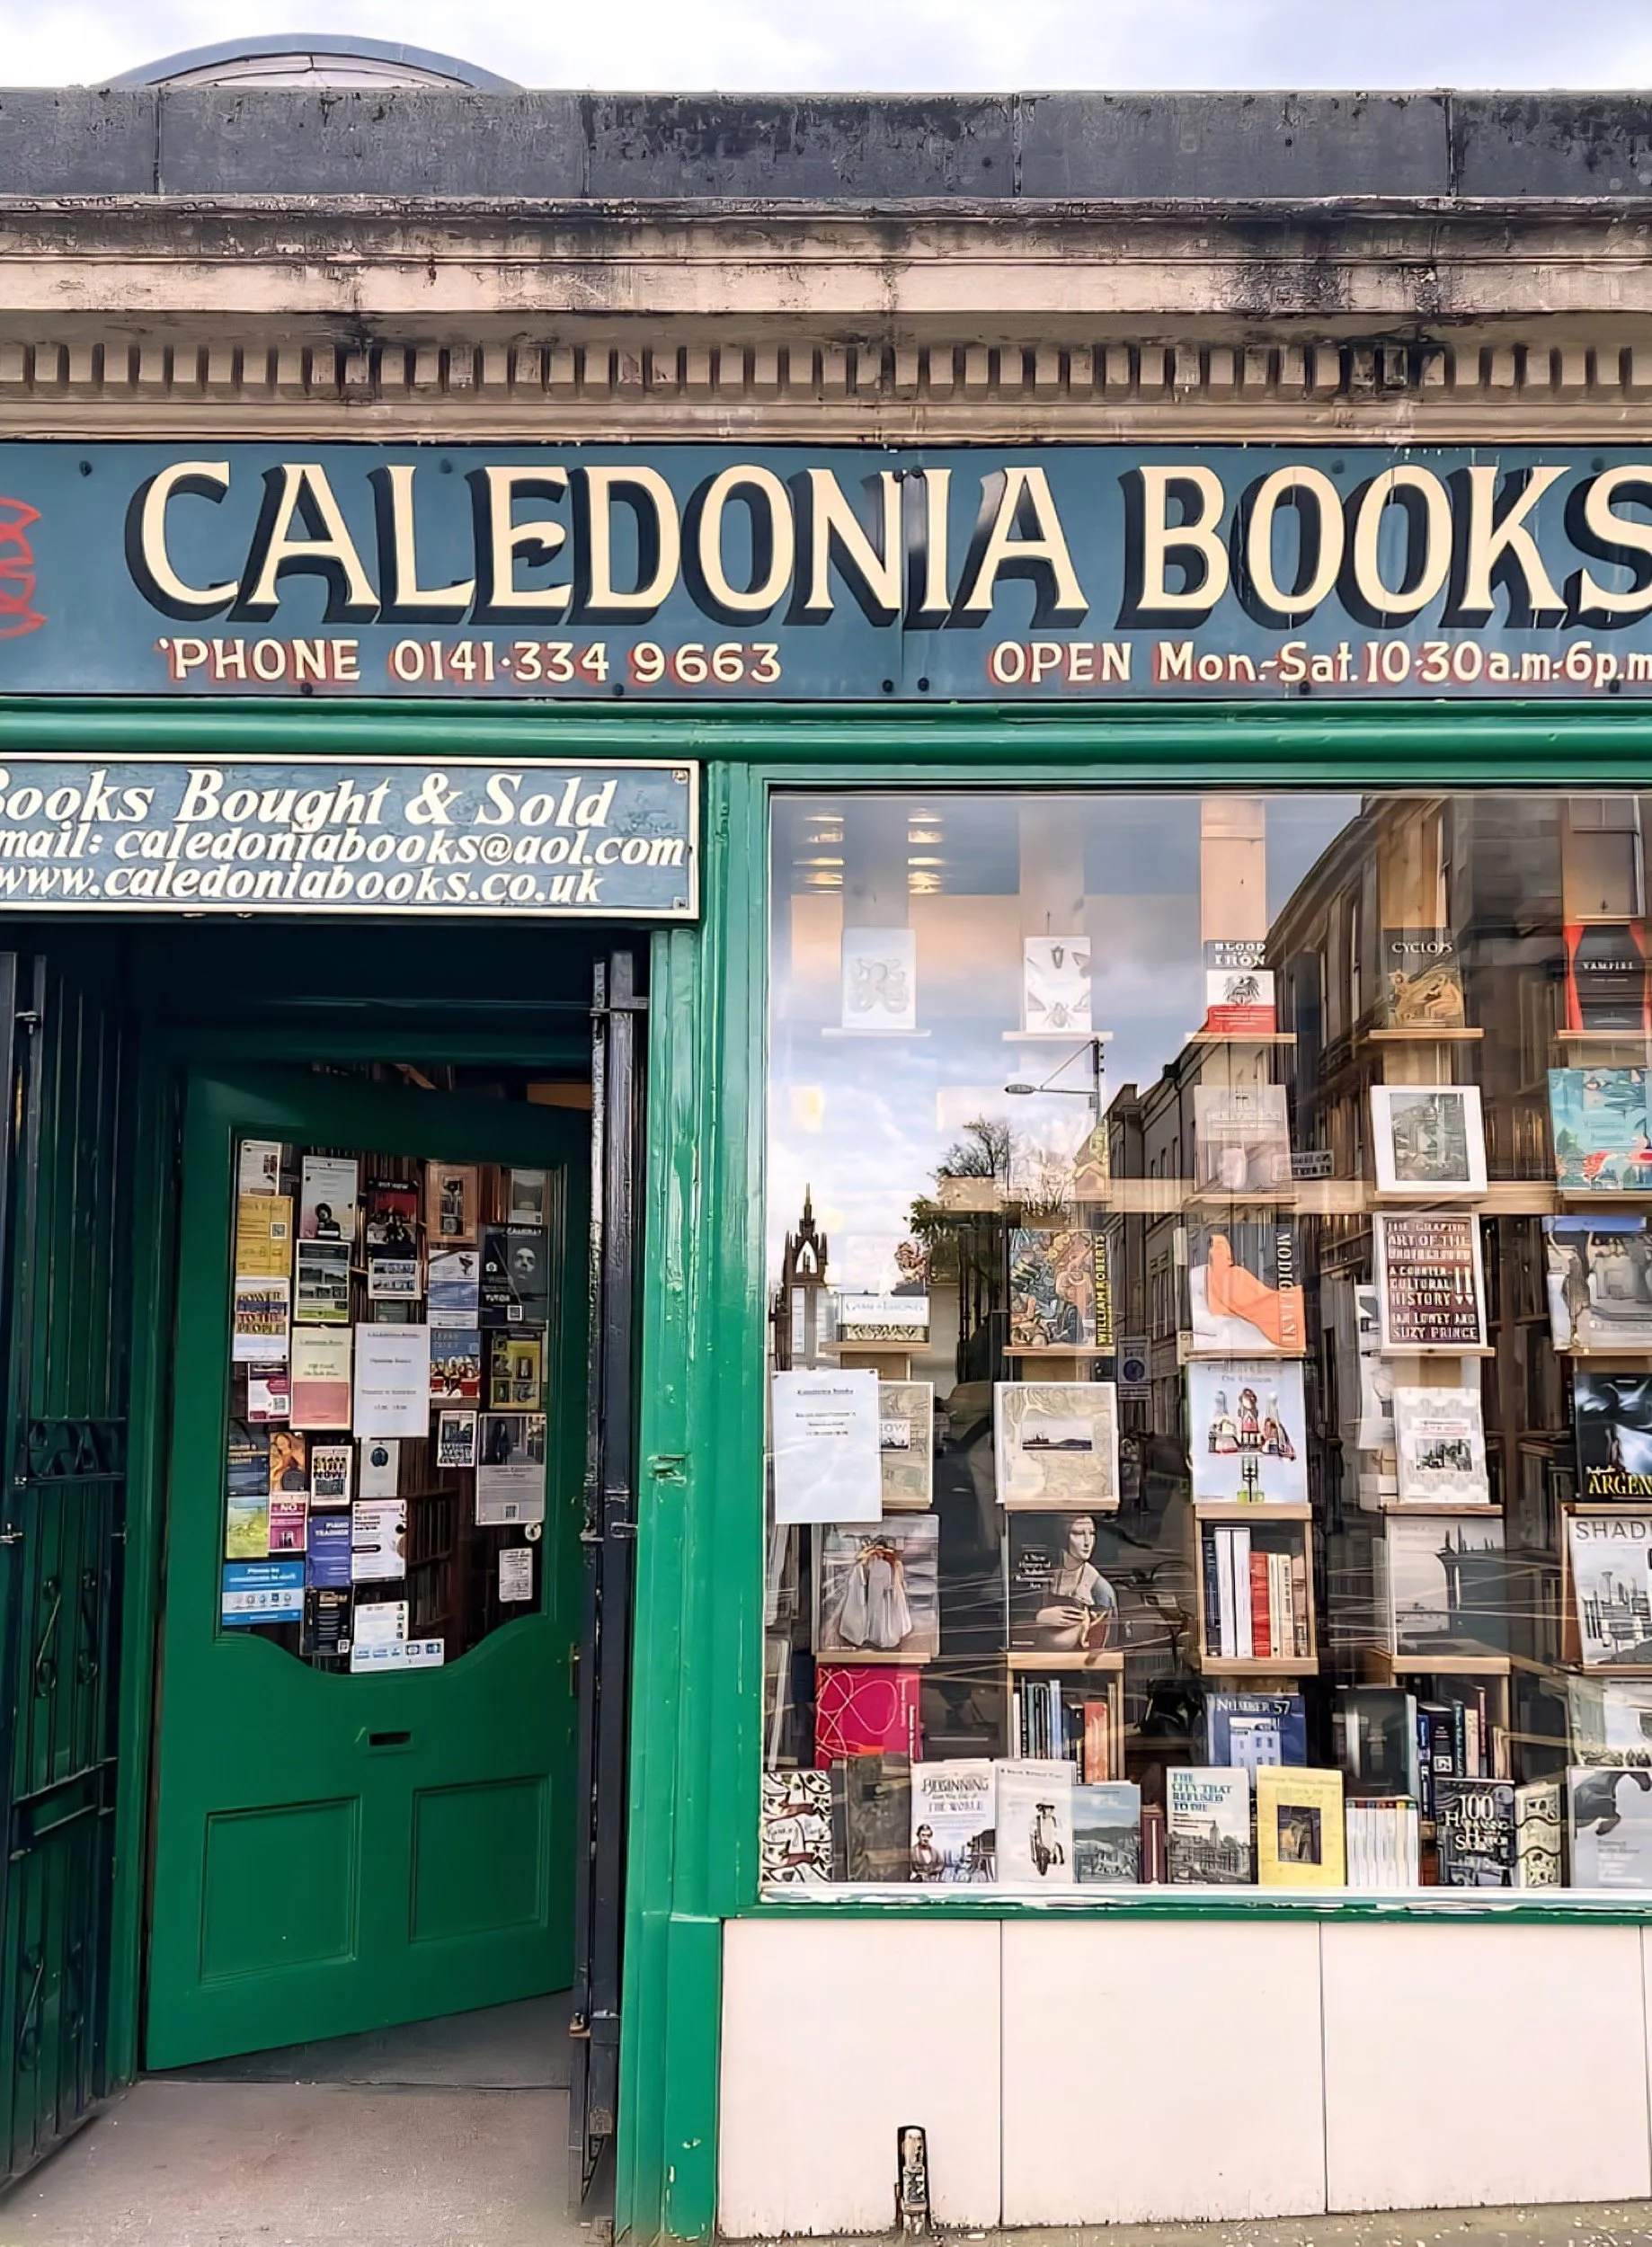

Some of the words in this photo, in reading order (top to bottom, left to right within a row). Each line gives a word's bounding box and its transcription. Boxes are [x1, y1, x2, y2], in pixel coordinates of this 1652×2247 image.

[128, 460, 1089, 622] CALEDONIA
[1116, 465, 1652, 629] BOOKS
[633, 641, 781, 683] 9663
[992, 641, 1132, 683] OPEN
[0, 767, 155, 822] ooks
[173, 768, 390, 833] Bought
[404, 773, 463, 825] &
[473, 773, 618, 828] Sold
[114, 823, 685, 866] caledoniabooks@aol.com
[0, 860, 606, 903] www.caledoniabooks.co.uk
[1388, 1235, 1416, 1247] ART
[1420, 1235, 1438, 1247] OF
[1442, 1236, 1470, 1248] THE
[1389, 1266, 1398, 1275] A
[1390, 1277, 1452, 1290] CULTURAL
[1390, 1292, 1452, 1307] HISTORY
[1392, 1327, 1426, 1339] SUZY
[1431, 1327, 1479, 1340] PRINCE
[1273, 1700, 1291, 1715] 57
[1199, 1784, 1232, 1794] THAT
